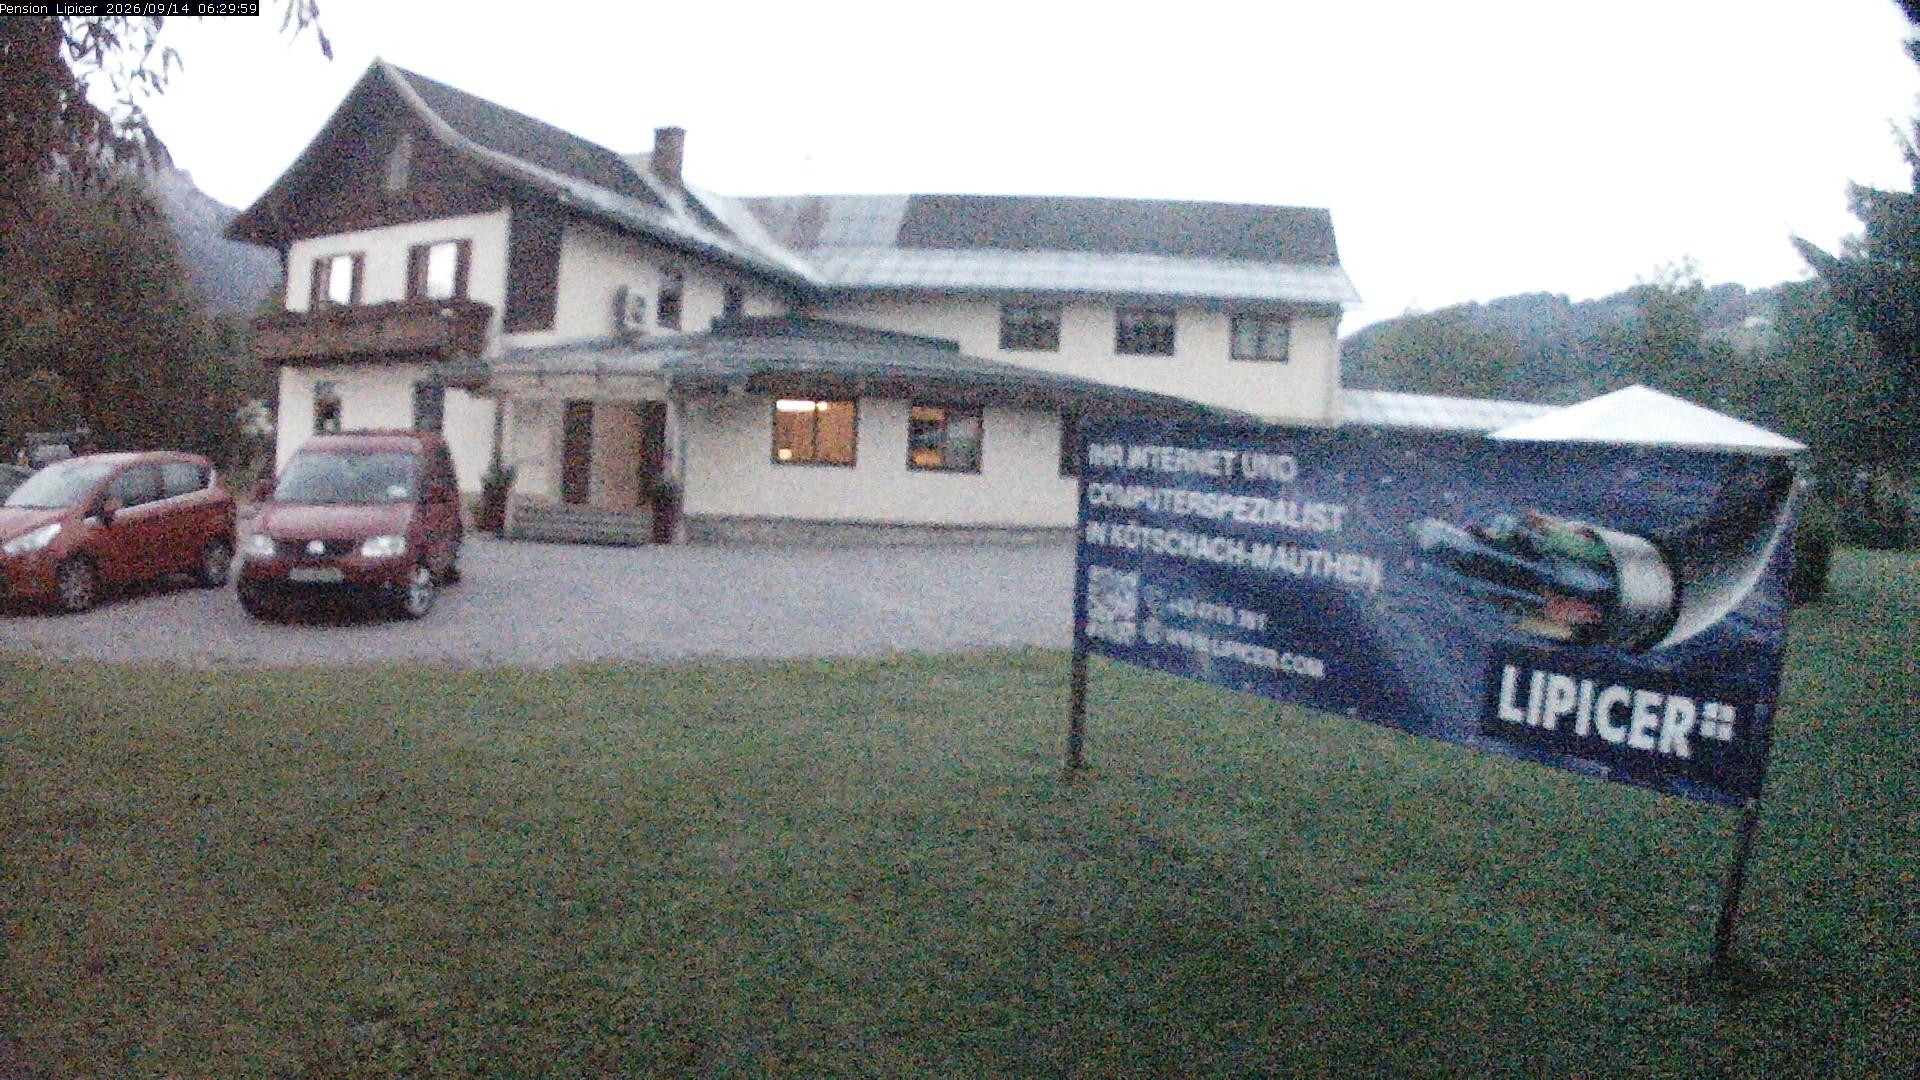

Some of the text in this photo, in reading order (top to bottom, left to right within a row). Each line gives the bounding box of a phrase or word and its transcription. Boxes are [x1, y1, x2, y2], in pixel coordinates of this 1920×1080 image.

[1128, 445, 1237, 477] INTERNET
[1241, 453, 1298, 482] UND
[1088, 482, 1347, 533] COMPUTERSPEZIALIST
[1498, 664, 1697, 759] LIPICER
